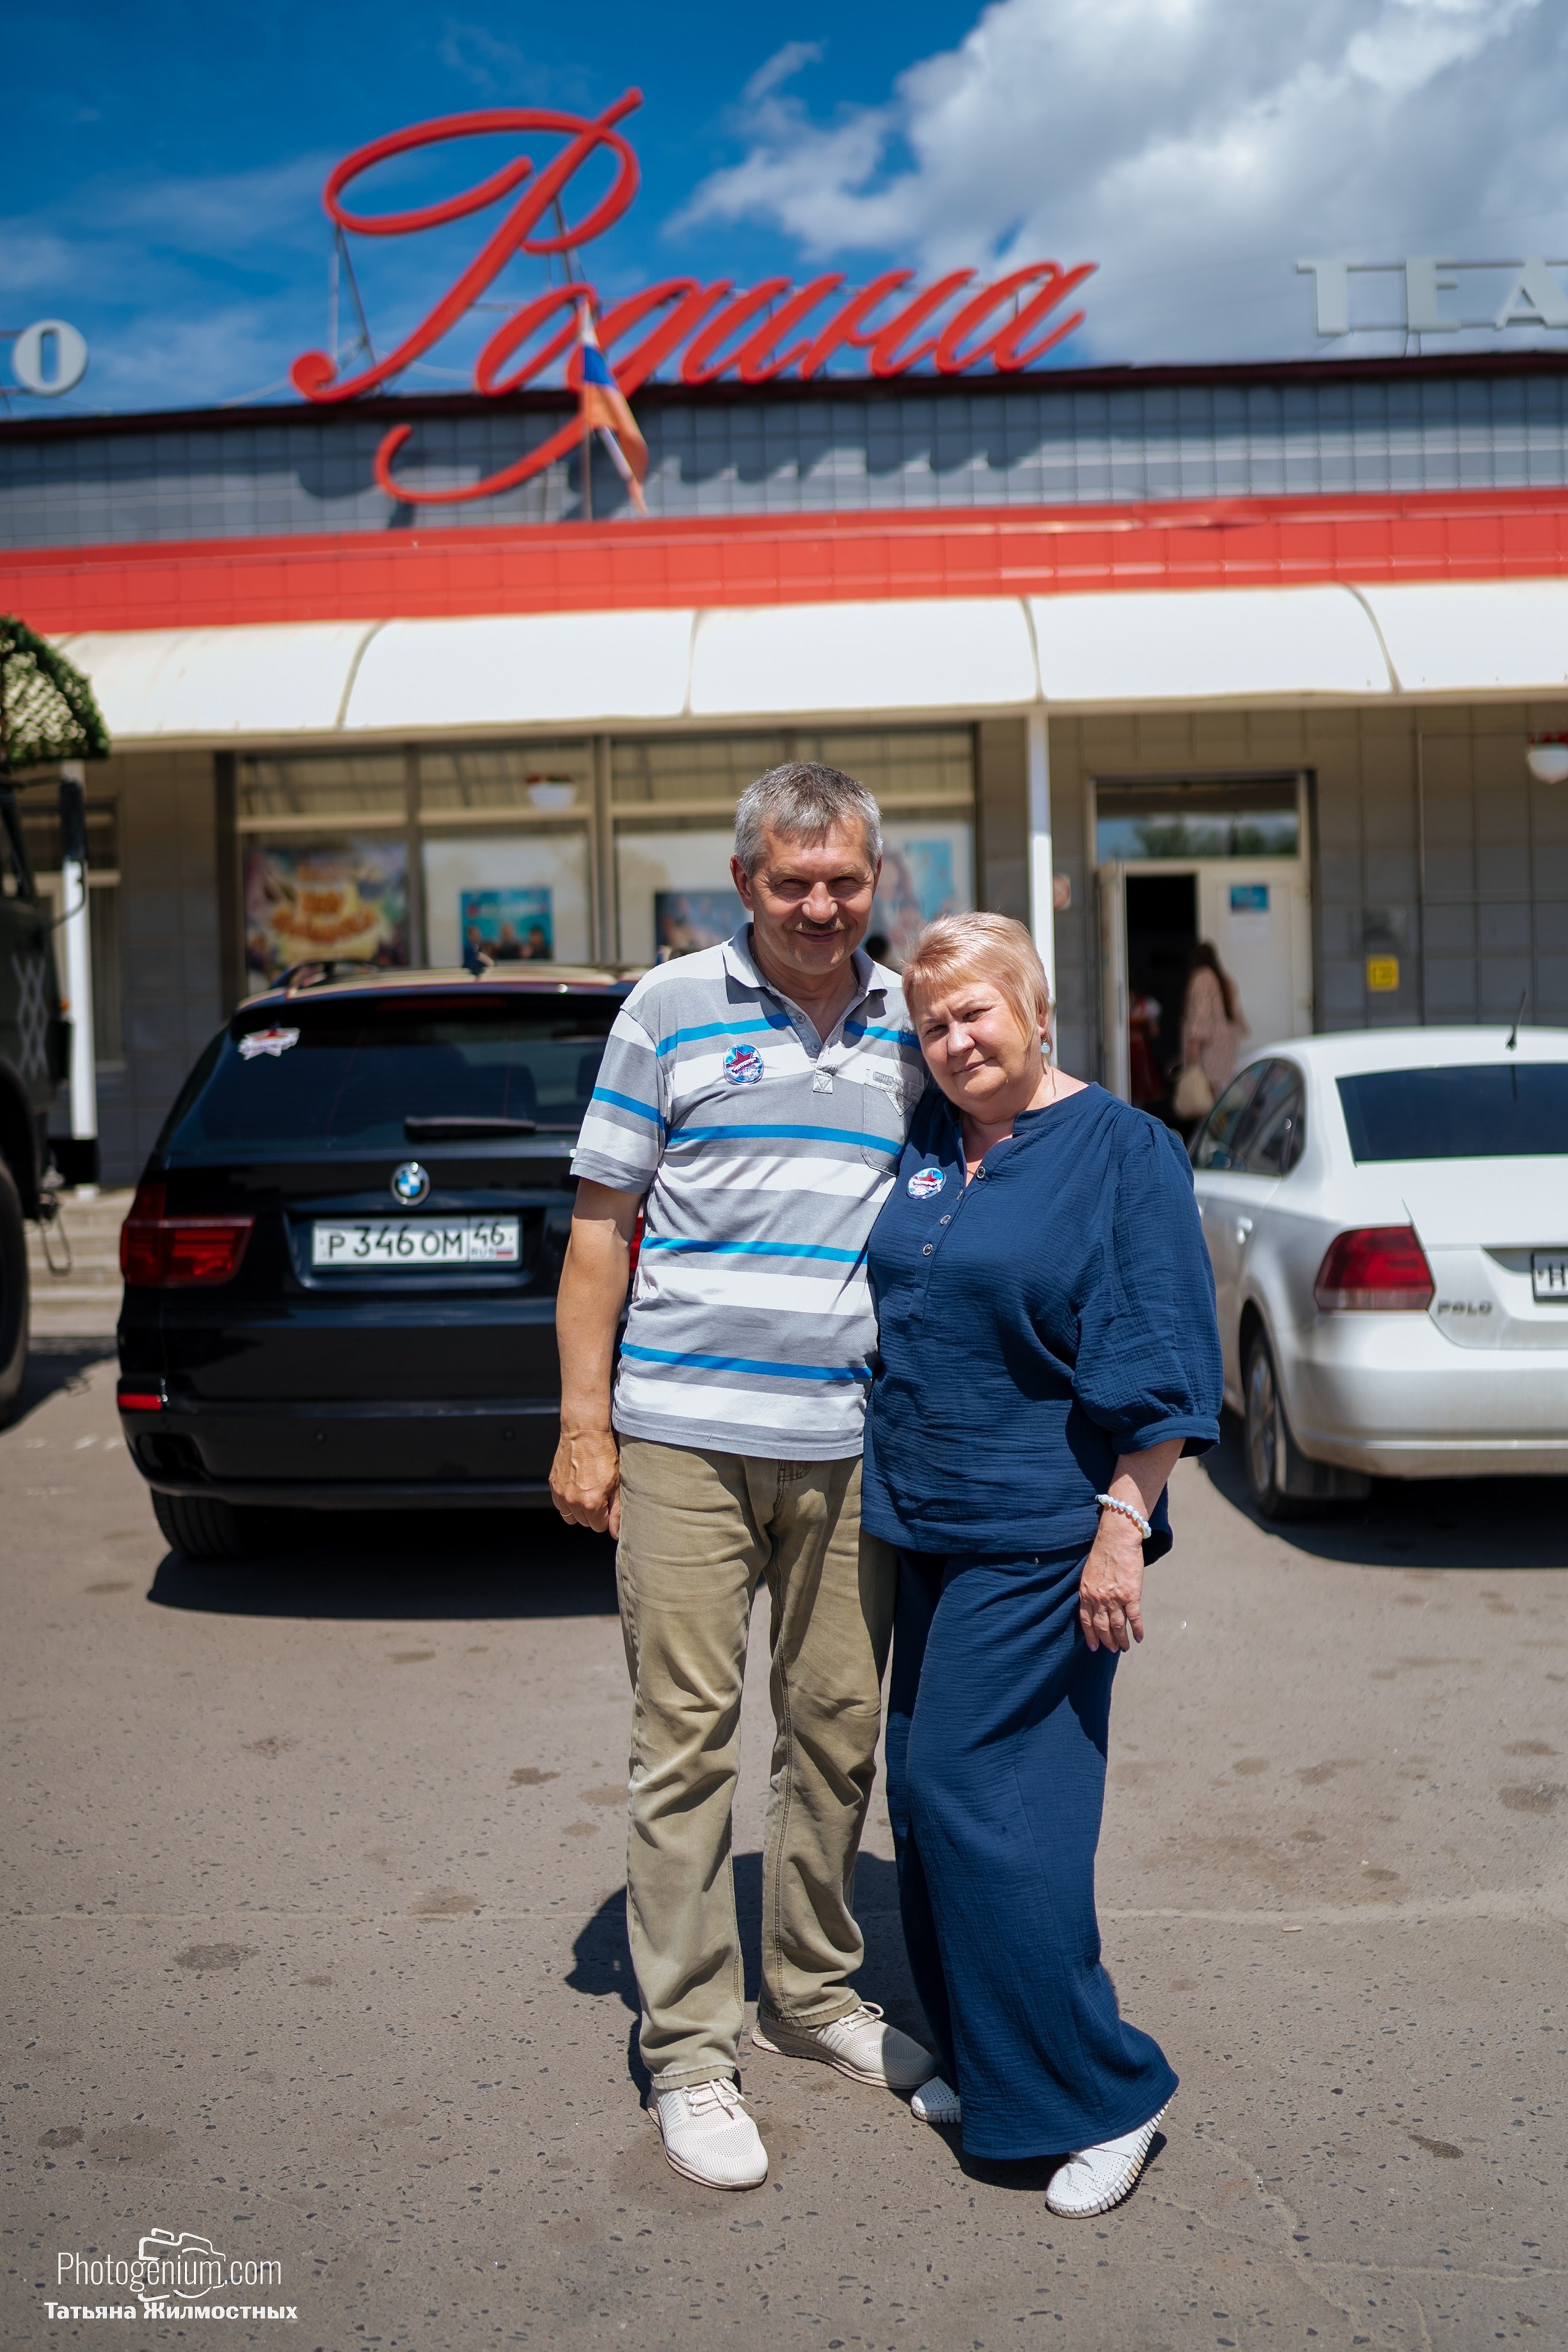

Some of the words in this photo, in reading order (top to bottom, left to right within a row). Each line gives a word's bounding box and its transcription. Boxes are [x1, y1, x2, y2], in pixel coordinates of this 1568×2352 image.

[291, 88, 1098, 504] Родина
[475, 1222, 505, 1246] 46
[1438, 1300, 1492, 1315] POLO
